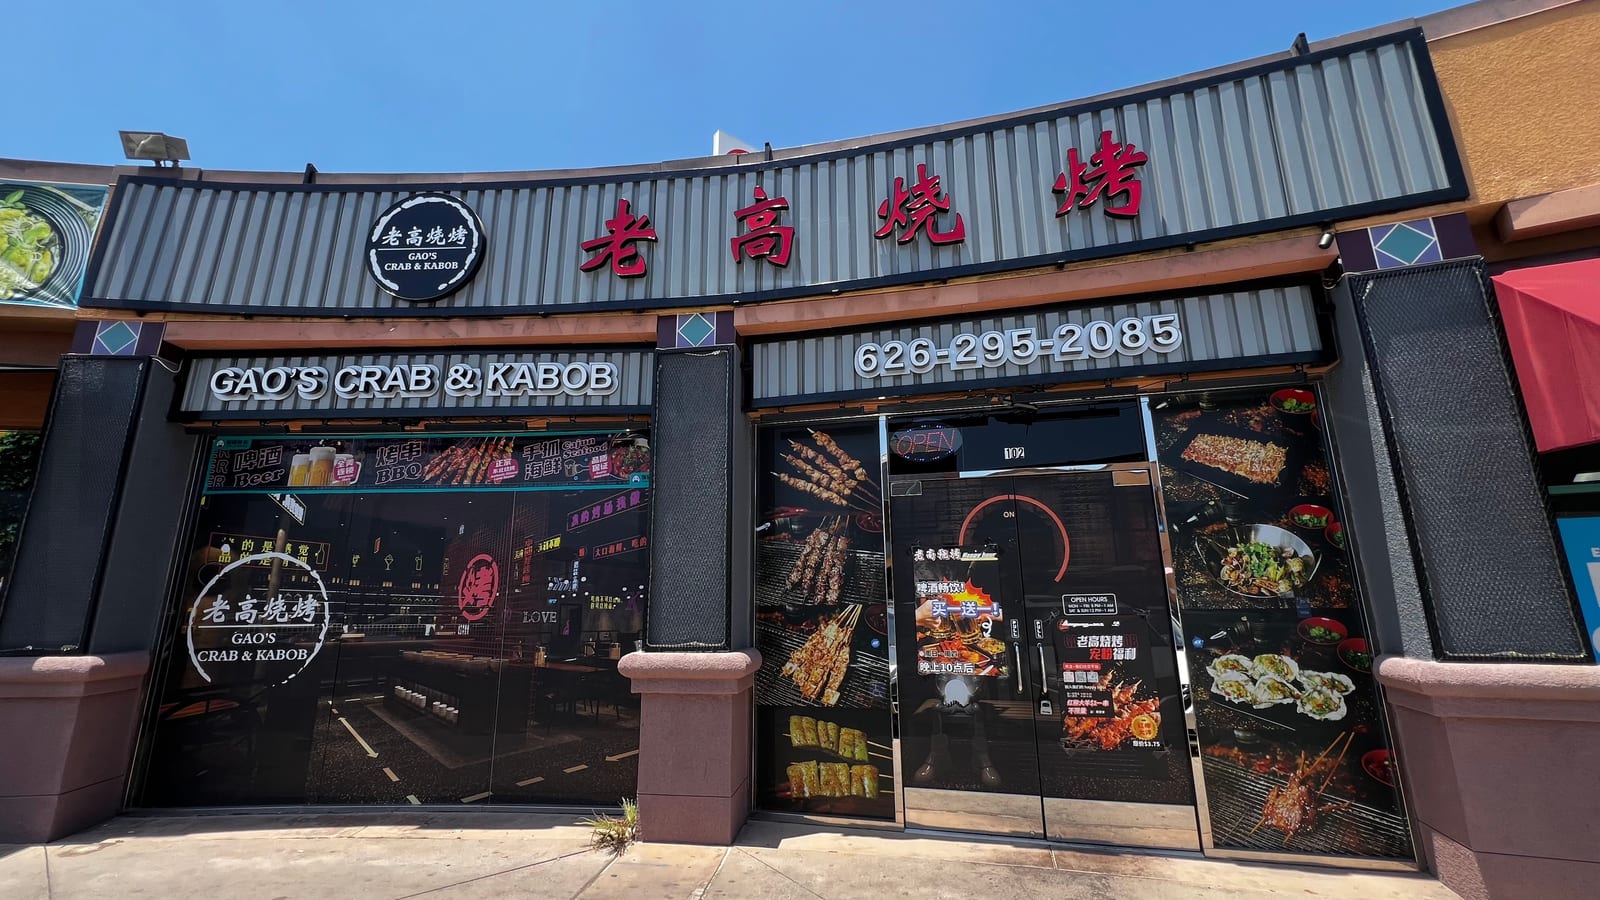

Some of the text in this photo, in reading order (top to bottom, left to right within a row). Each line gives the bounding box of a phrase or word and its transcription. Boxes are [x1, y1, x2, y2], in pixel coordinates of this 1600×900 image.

[580, 130, 1148, 279] 老高烧烤
[381, 225, 468, 247] 老高烧烤
[384, 262, 412, 271] CRAB
[423, 261, 458, 270] KABOB
[408, 252, 437, 261] GAO'S
[853, 313, 1182, 379] 626-295-2085
[210, 361, 618, 400] GAO'S CRAB & KABOB
[375, 440, 422, 468] 烤串
[896, 429, 955, 457] OPEN
[1004, 447, 1025, 460] 102
[233, 445, 284, 472] 啤酒
[524, 457, 562, 480] 海鲜
[234, 468, 285, 488] Beer
[375, 462, 423, 485] BBQ
[202, 594, 319, 623] 老高烧烤
[523, 611, 557, 623] LOVE
[231, 632, 276, 645] GAO'S
[1077, 635, 1124, 648] 老高烧烤
[198, 649, 308, 661] CRAB & KABOB
[919, 662, 974, 674] 晚上10点后
